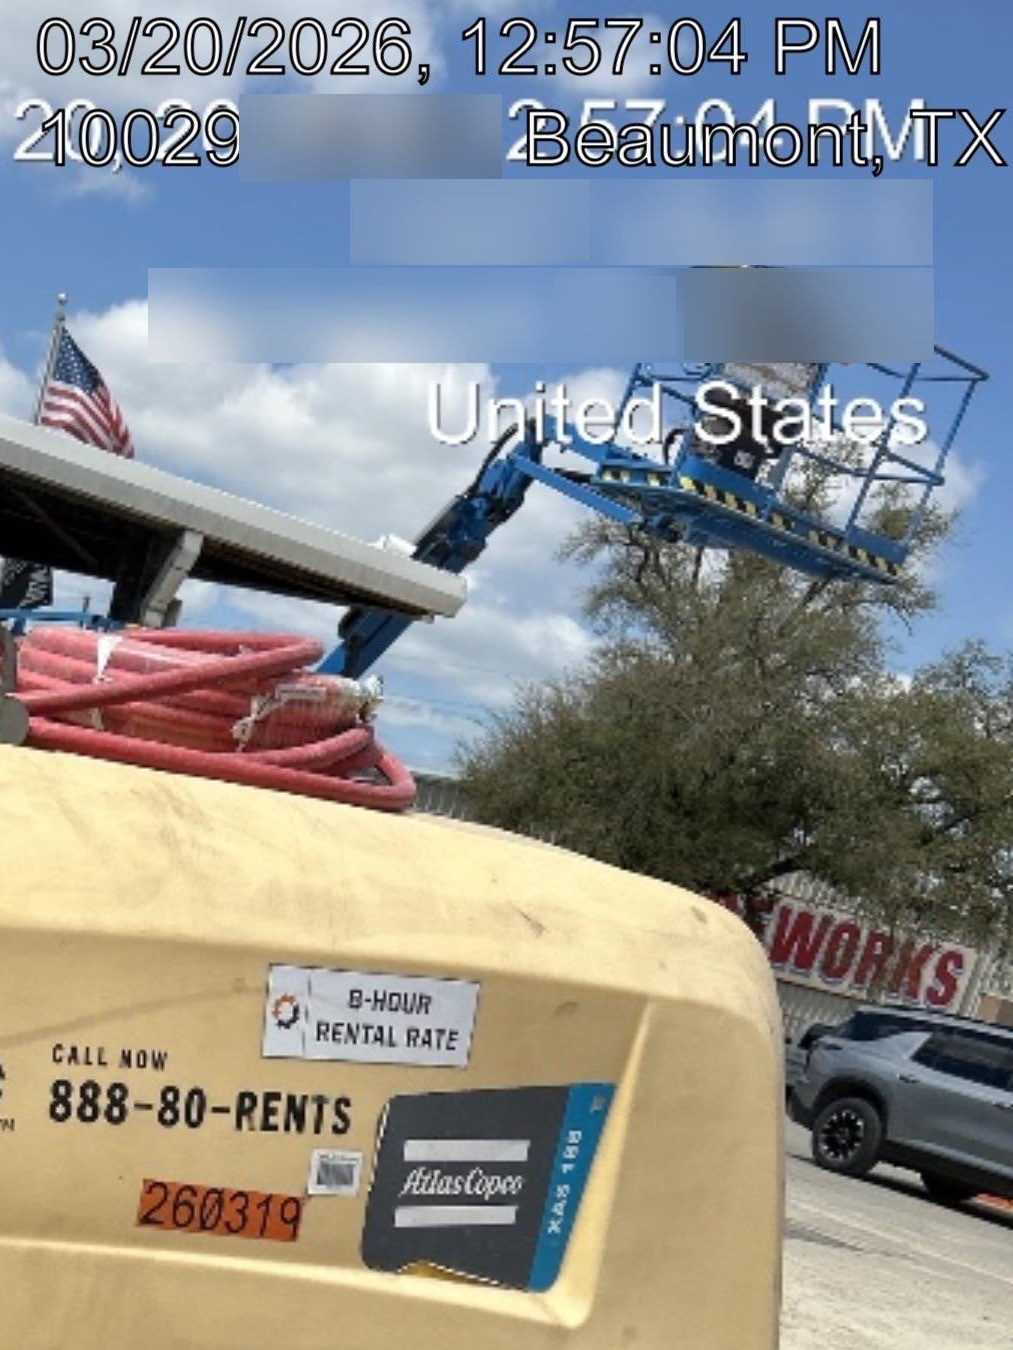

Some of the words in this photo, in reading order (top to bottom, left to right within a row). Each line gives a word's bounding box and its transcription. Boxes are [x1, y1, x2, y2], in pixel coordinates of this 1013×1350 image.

[768, 902, 966, 1008] WORKS
[51, 1043, 108, 1067] CALL
[118, 1047, 169, 1072] NOW
[315, 1021, 397, 1048] RENTAL
[405, 1028, 460, 1051] RATE
[49, 1078, 353, 1136] 888-80-RENTS
[139, 1181, 302, 1237] 260319
[547, 1184, 571, 1235] XAS
